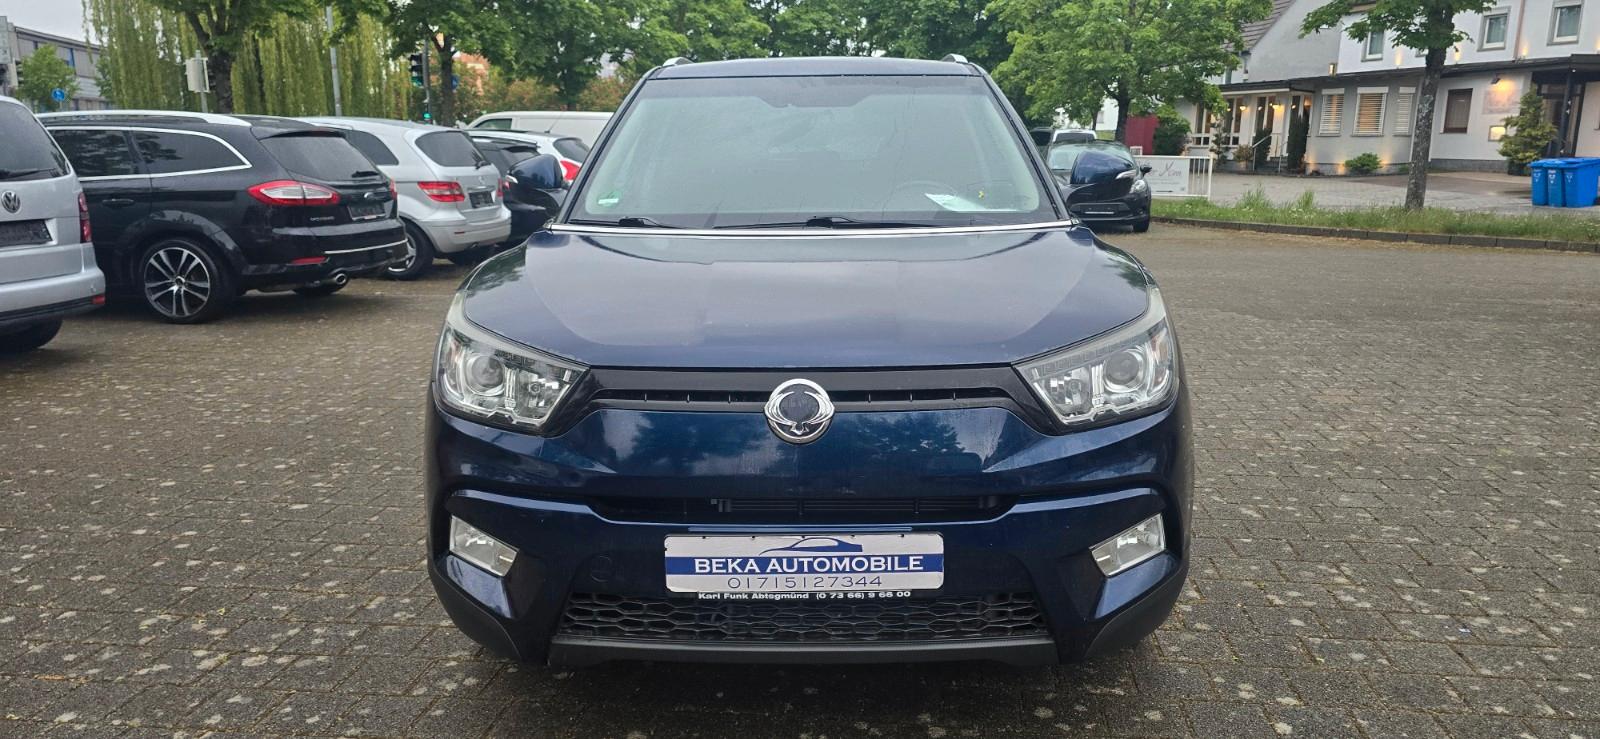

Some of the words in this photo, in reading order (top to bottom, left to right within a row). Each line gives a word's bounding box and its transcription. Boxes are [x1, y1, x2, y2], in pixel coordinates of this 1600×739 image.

[694, 558, 761, 574] BEKA
[764, 556, 924, 573] AUTOMOBILE
[727, 576, 882, 589] 01715127344
[698, 592, 721, 600] Karl
[723, 592, 749, 600] Funk
[816, 592, 826, 600] (0
[847, 592, 865, 600] 66)
